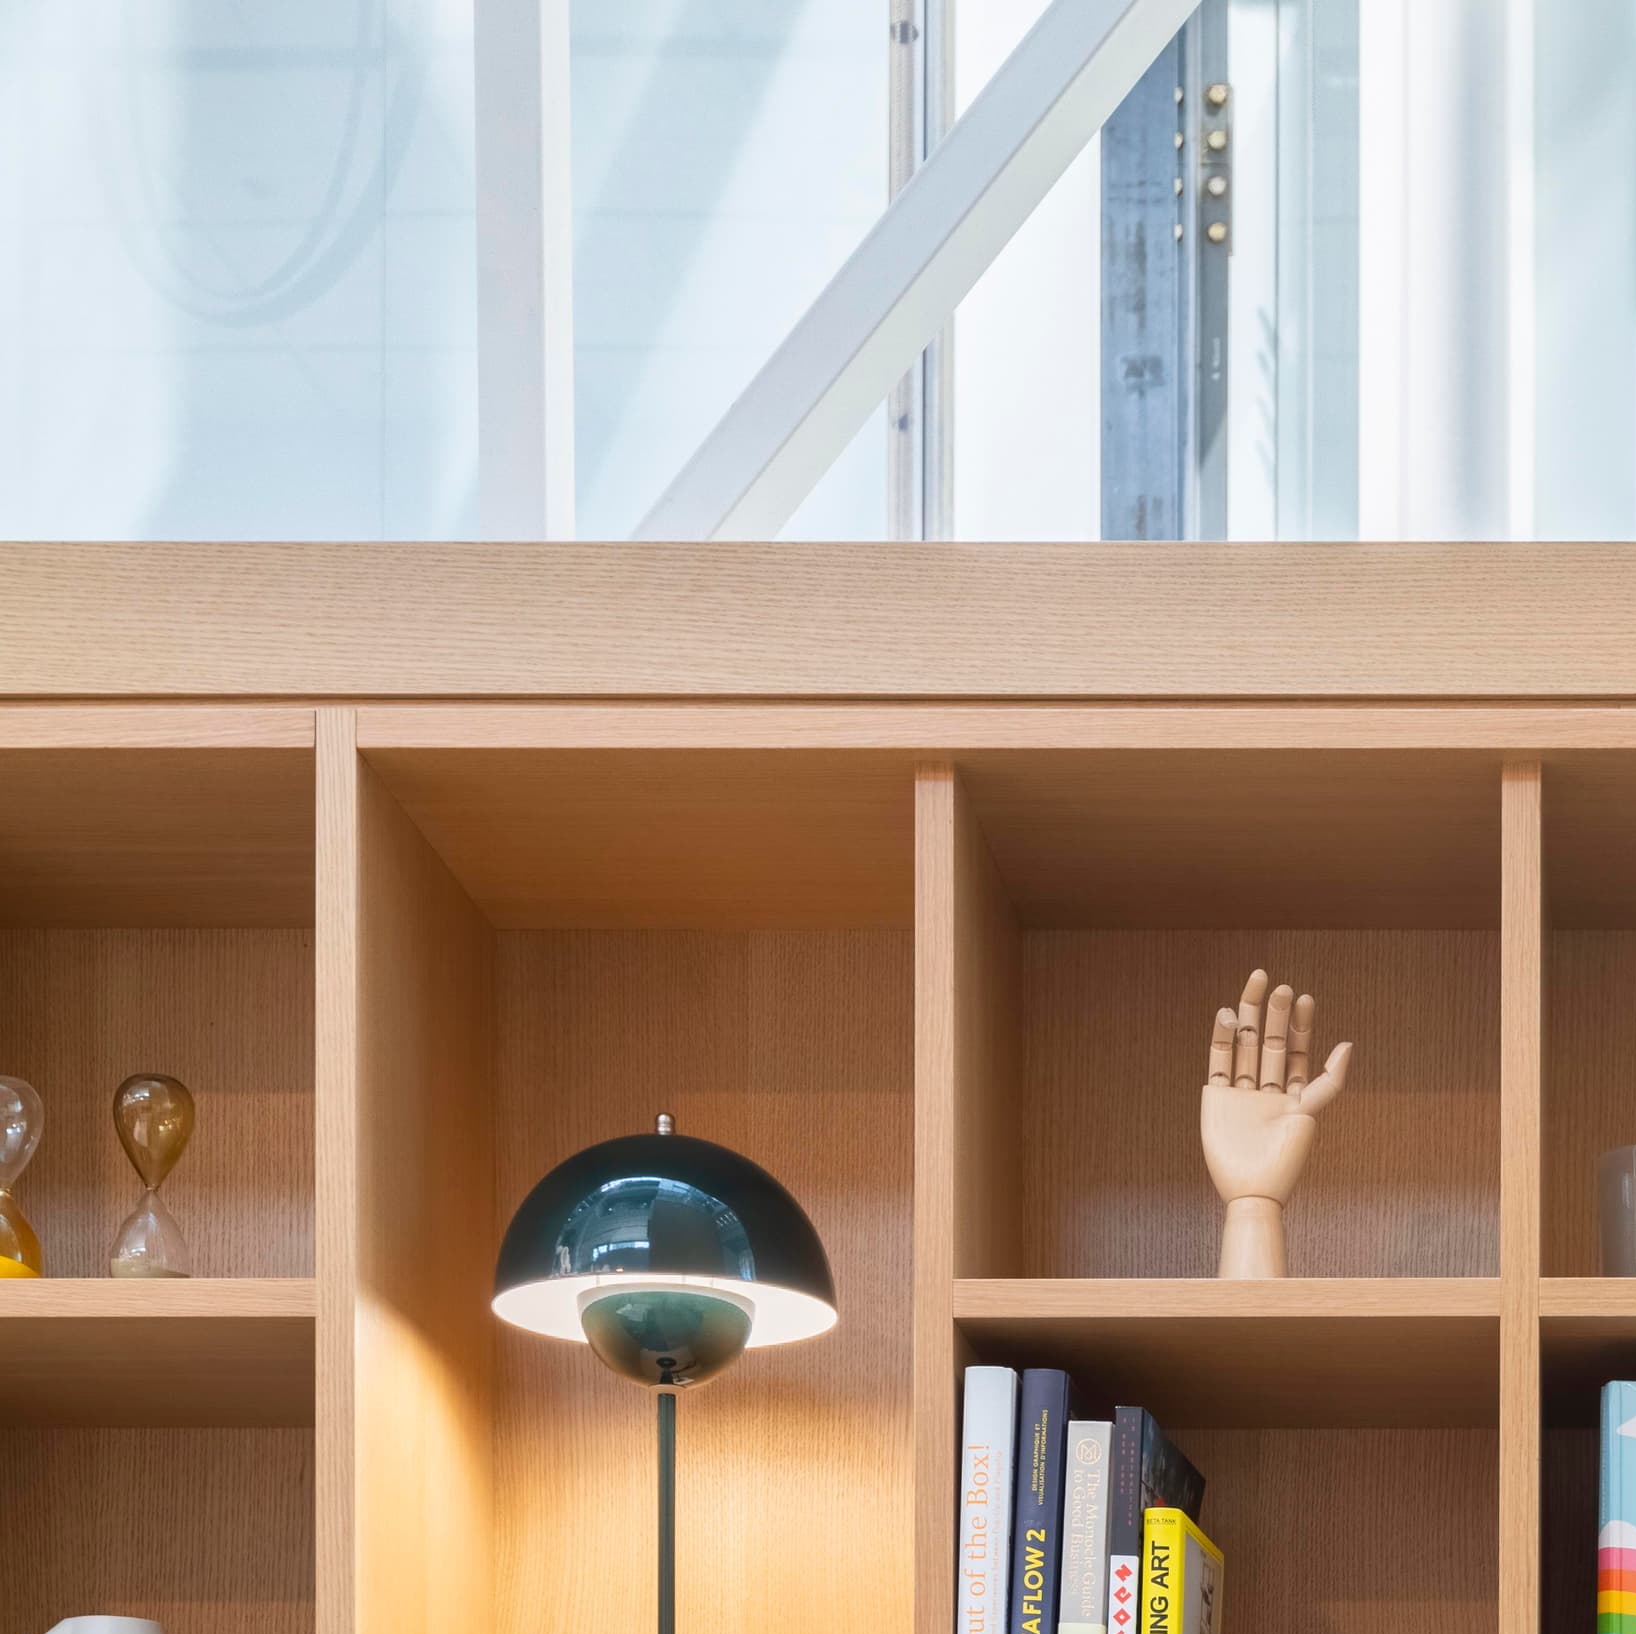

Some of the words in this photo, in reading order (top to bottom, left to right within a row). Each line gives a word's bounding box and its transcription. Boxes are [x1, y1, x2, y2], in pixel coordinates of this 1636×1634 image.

[966, 1446, 990, 1506] Box!
[965, 1517, 987, 1561] the
[1026, 1529, 1045, 1542] 2
[964, 1567, 986, 1596] of
[1151, 1541, 1169, 1588] ART
